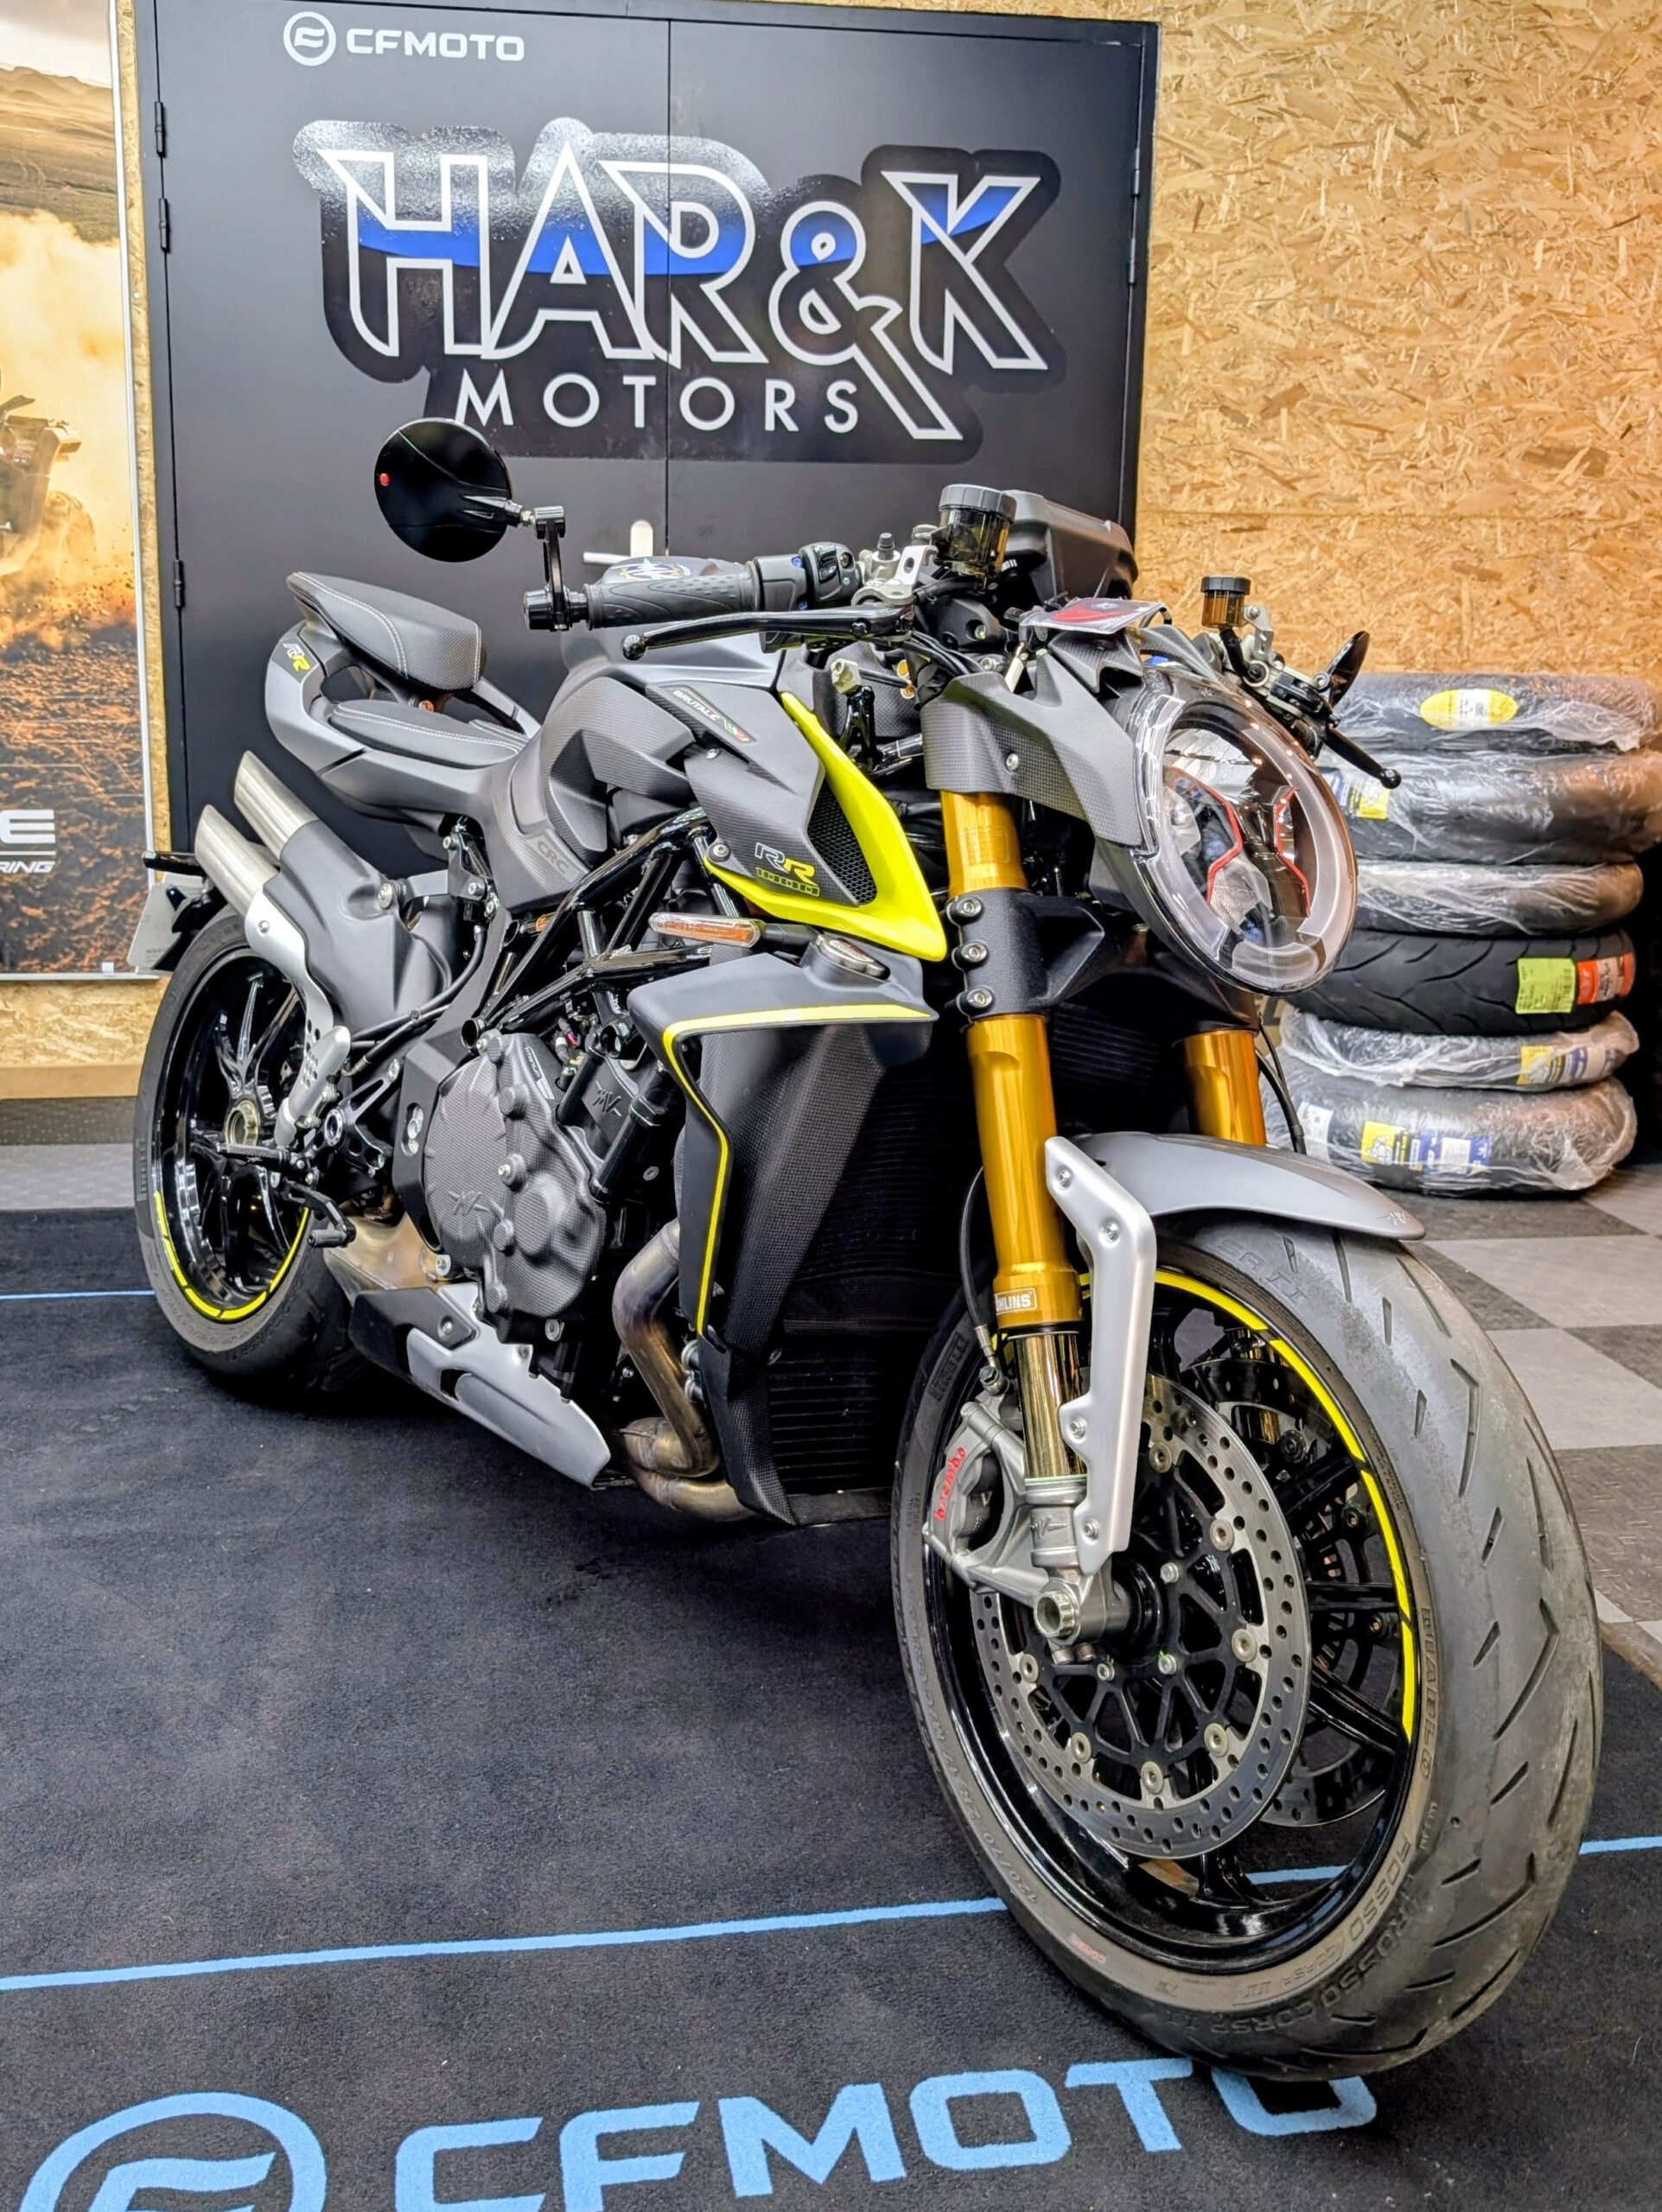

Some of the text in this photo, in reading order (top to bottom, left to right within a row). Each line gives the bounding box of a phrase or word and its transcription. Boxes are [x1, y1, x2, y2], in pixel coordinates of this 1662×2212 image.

[347, 28, 525, 62] CFMOTO
[455, 369, 859, 434] MOTORS
[673, 690, 720, 721] BRUTALE
[755, 842, 818, 887] RR
[934, 1447, 965, 1522] brembo
[1420, 1608, 1438, 1779] DIABLO
